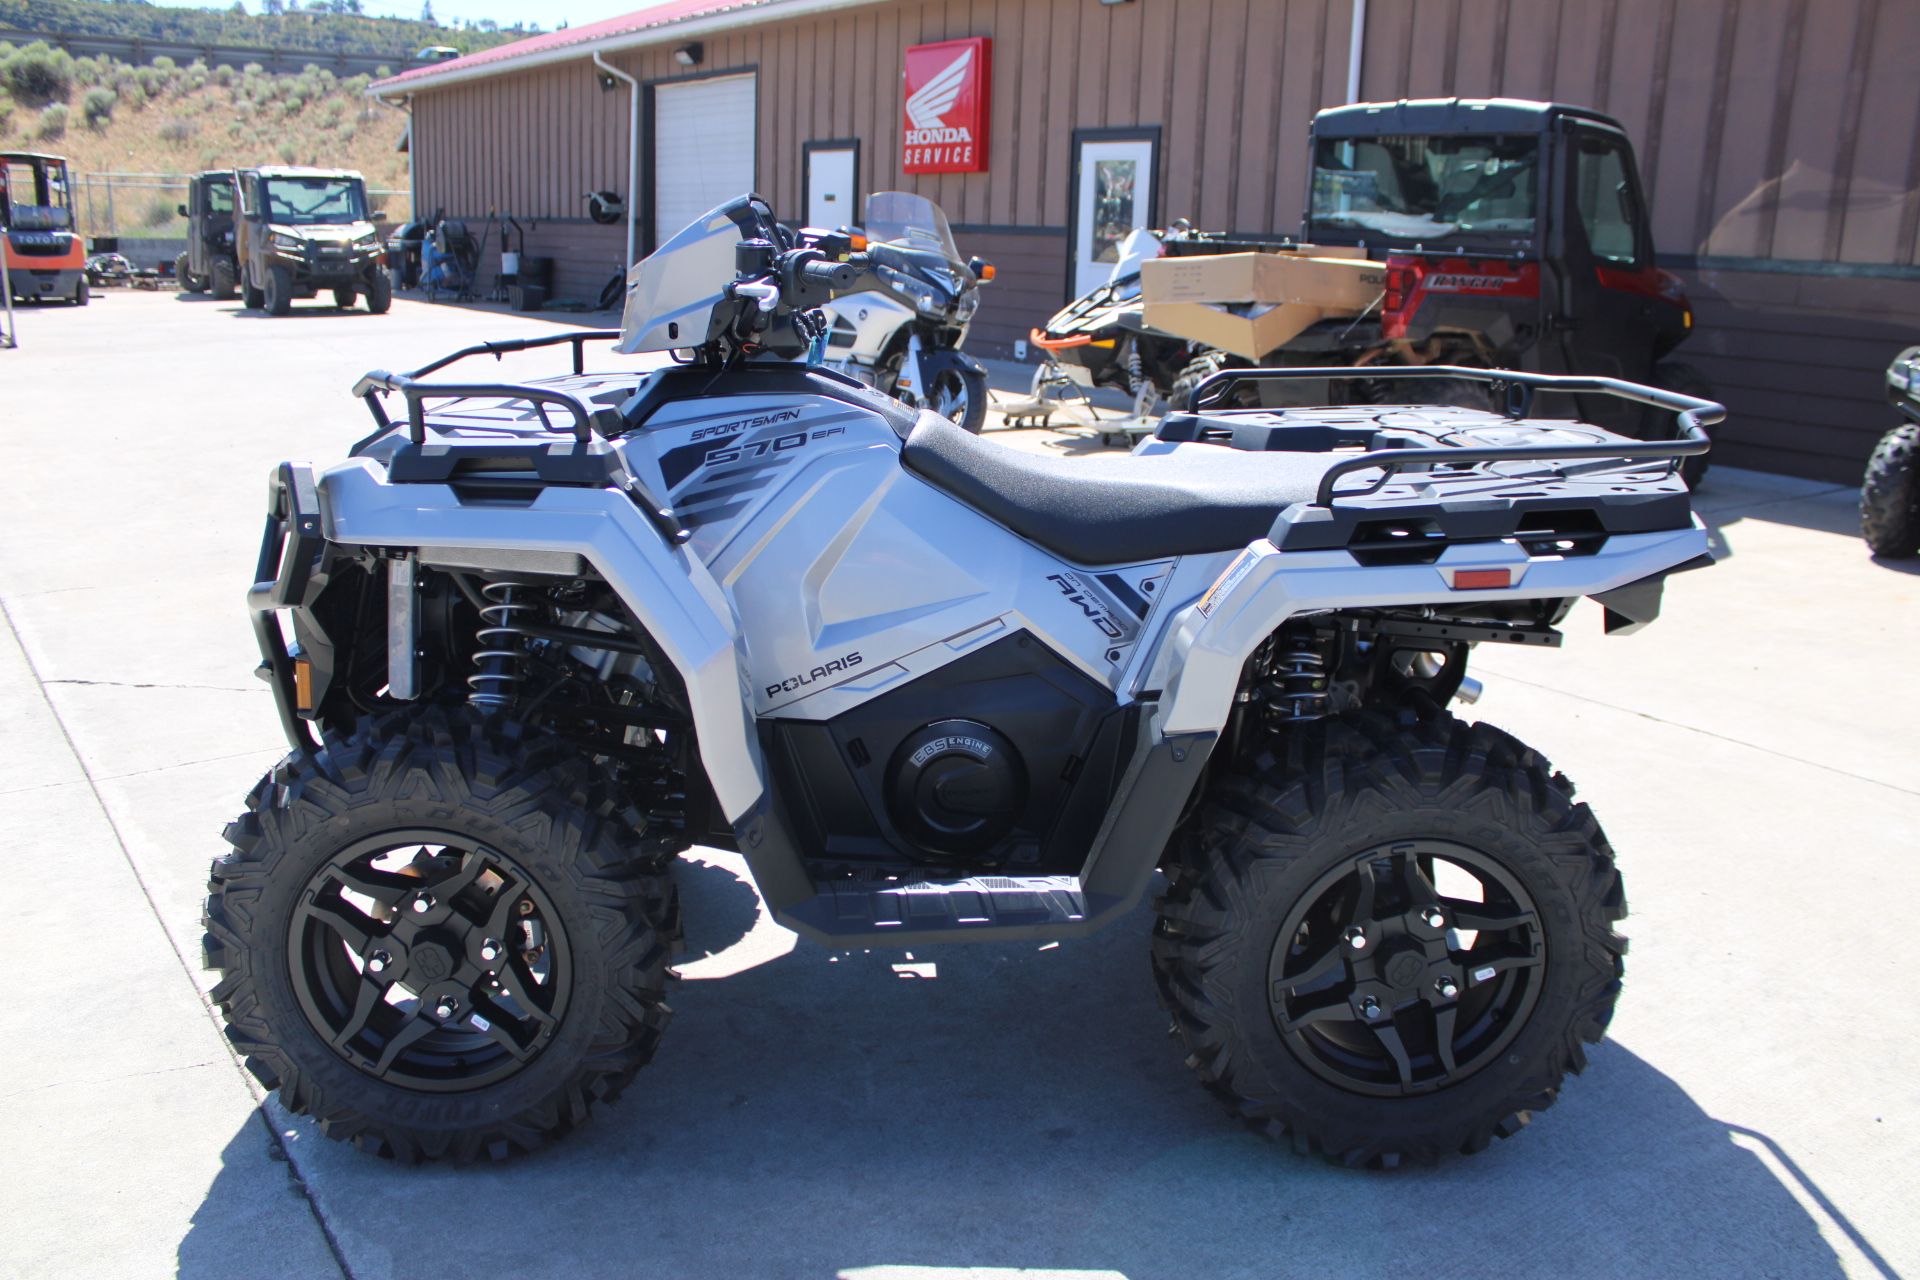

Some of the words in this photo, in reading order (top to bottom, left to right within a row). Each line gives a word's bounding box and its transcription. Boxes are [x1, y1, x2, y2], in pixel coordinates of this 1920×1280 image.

[905, 127, 973, 145] HONDA
[904, 146, 972, 165] SERVICE
[18, 235, 66, 245] TOYOTA
[1433, 275, 1505, 289] RANGER
[689, 408, 800, 442] SPORTSMAN
[704, 432, 808, 468] 570
[811, 426, 846, 440] EFI
[1045, 574, 1122, 638] AWD
[765, 651, 863, 699] POLARIS
[913, 739, 946, 763] EBS
[948, 736, 991, 753] ENGINE
